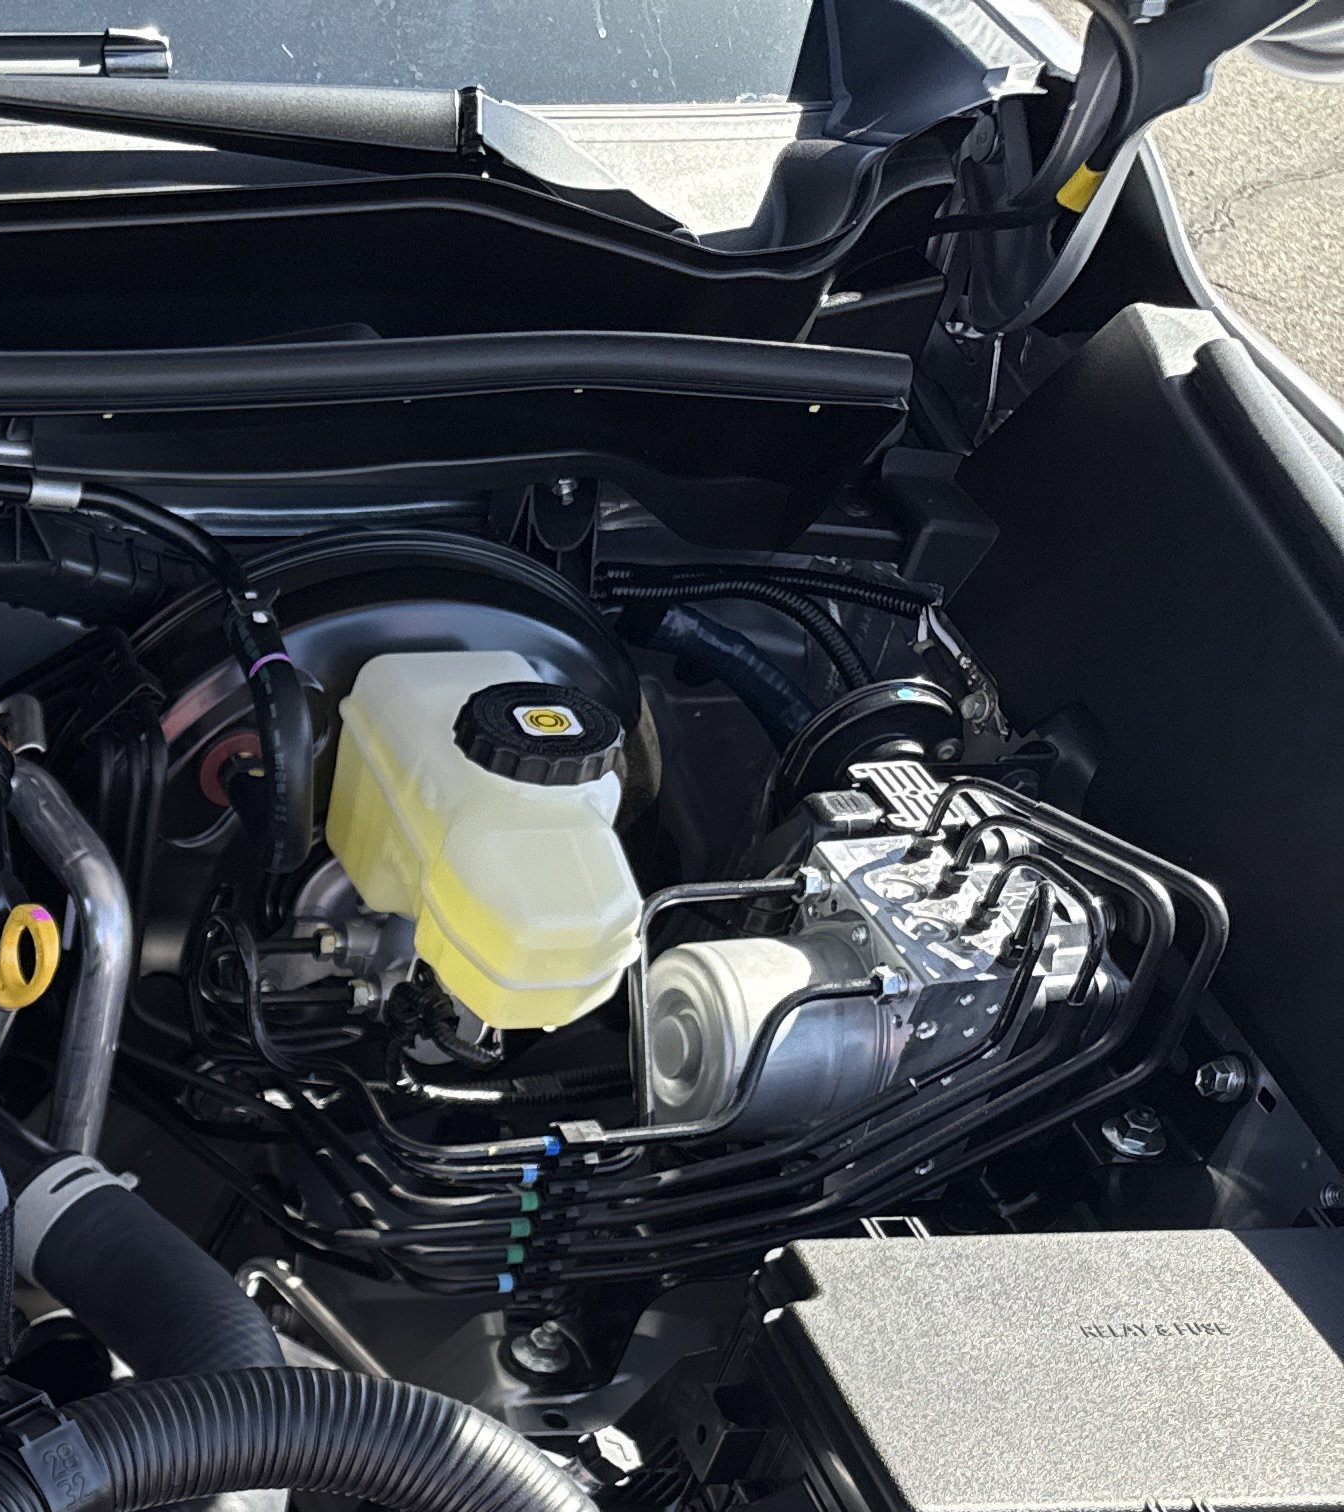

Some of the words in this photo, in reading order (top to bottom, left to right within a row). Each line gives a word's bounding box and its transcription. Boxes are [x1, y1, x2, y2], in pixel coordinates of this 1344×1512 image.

[1079, 1322, 1148, 1338] RELAY
[1154, 1323, 1173, 1337] &
[1173, 1322, 1231, 1336] FUSE
